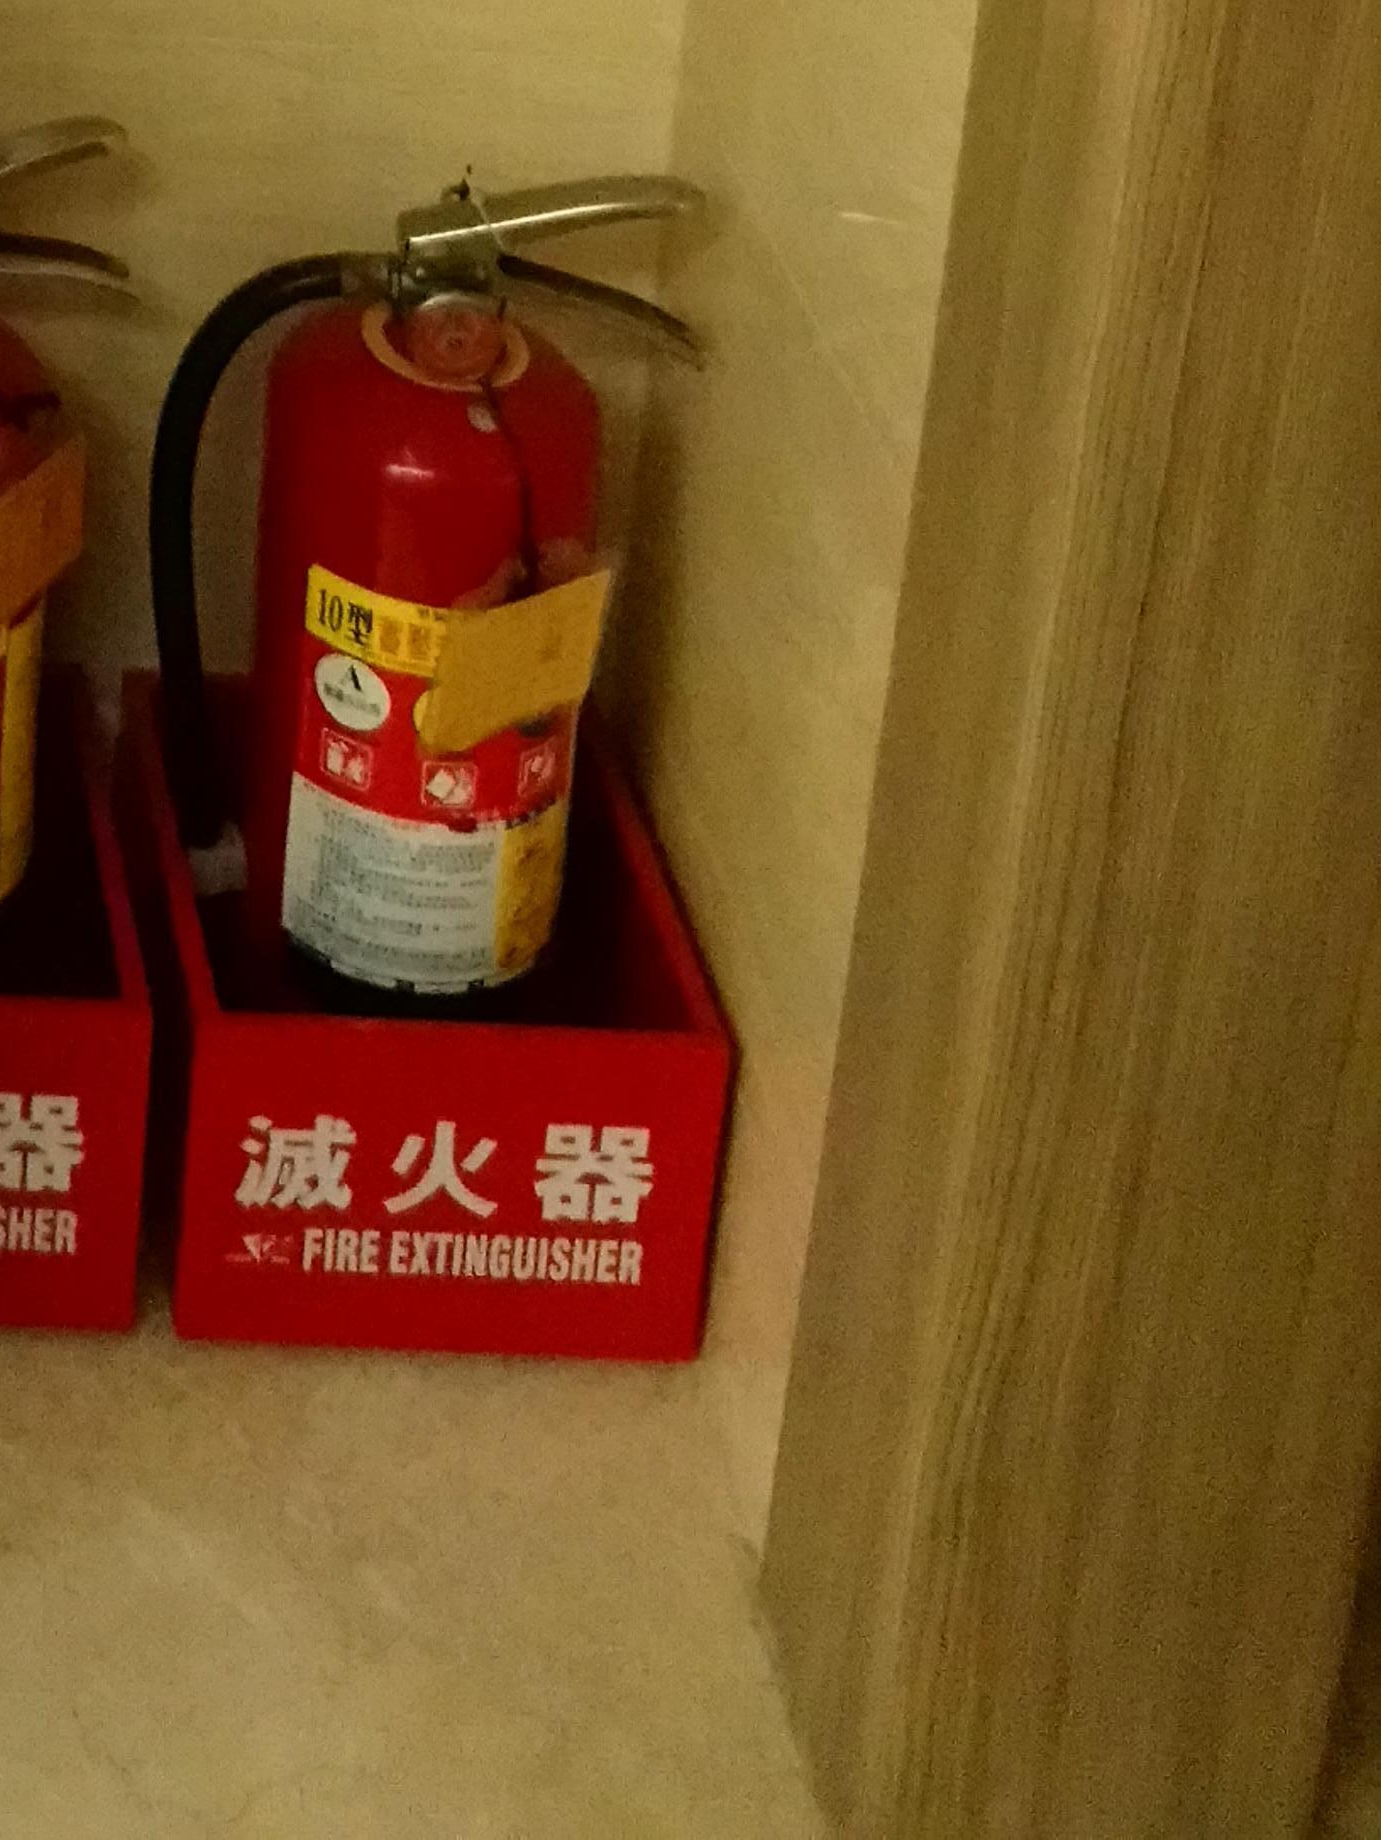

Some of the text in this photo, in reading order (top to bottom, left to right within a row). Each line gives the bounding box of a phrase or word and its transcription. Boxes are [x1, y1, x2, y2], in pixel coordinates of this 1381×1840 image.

[235, 1114, 654, 1224] 滅火器
[302, 1228, 381, 1274] FIRE
[389, 1231, 644, 1286] EXTINGUISHER
